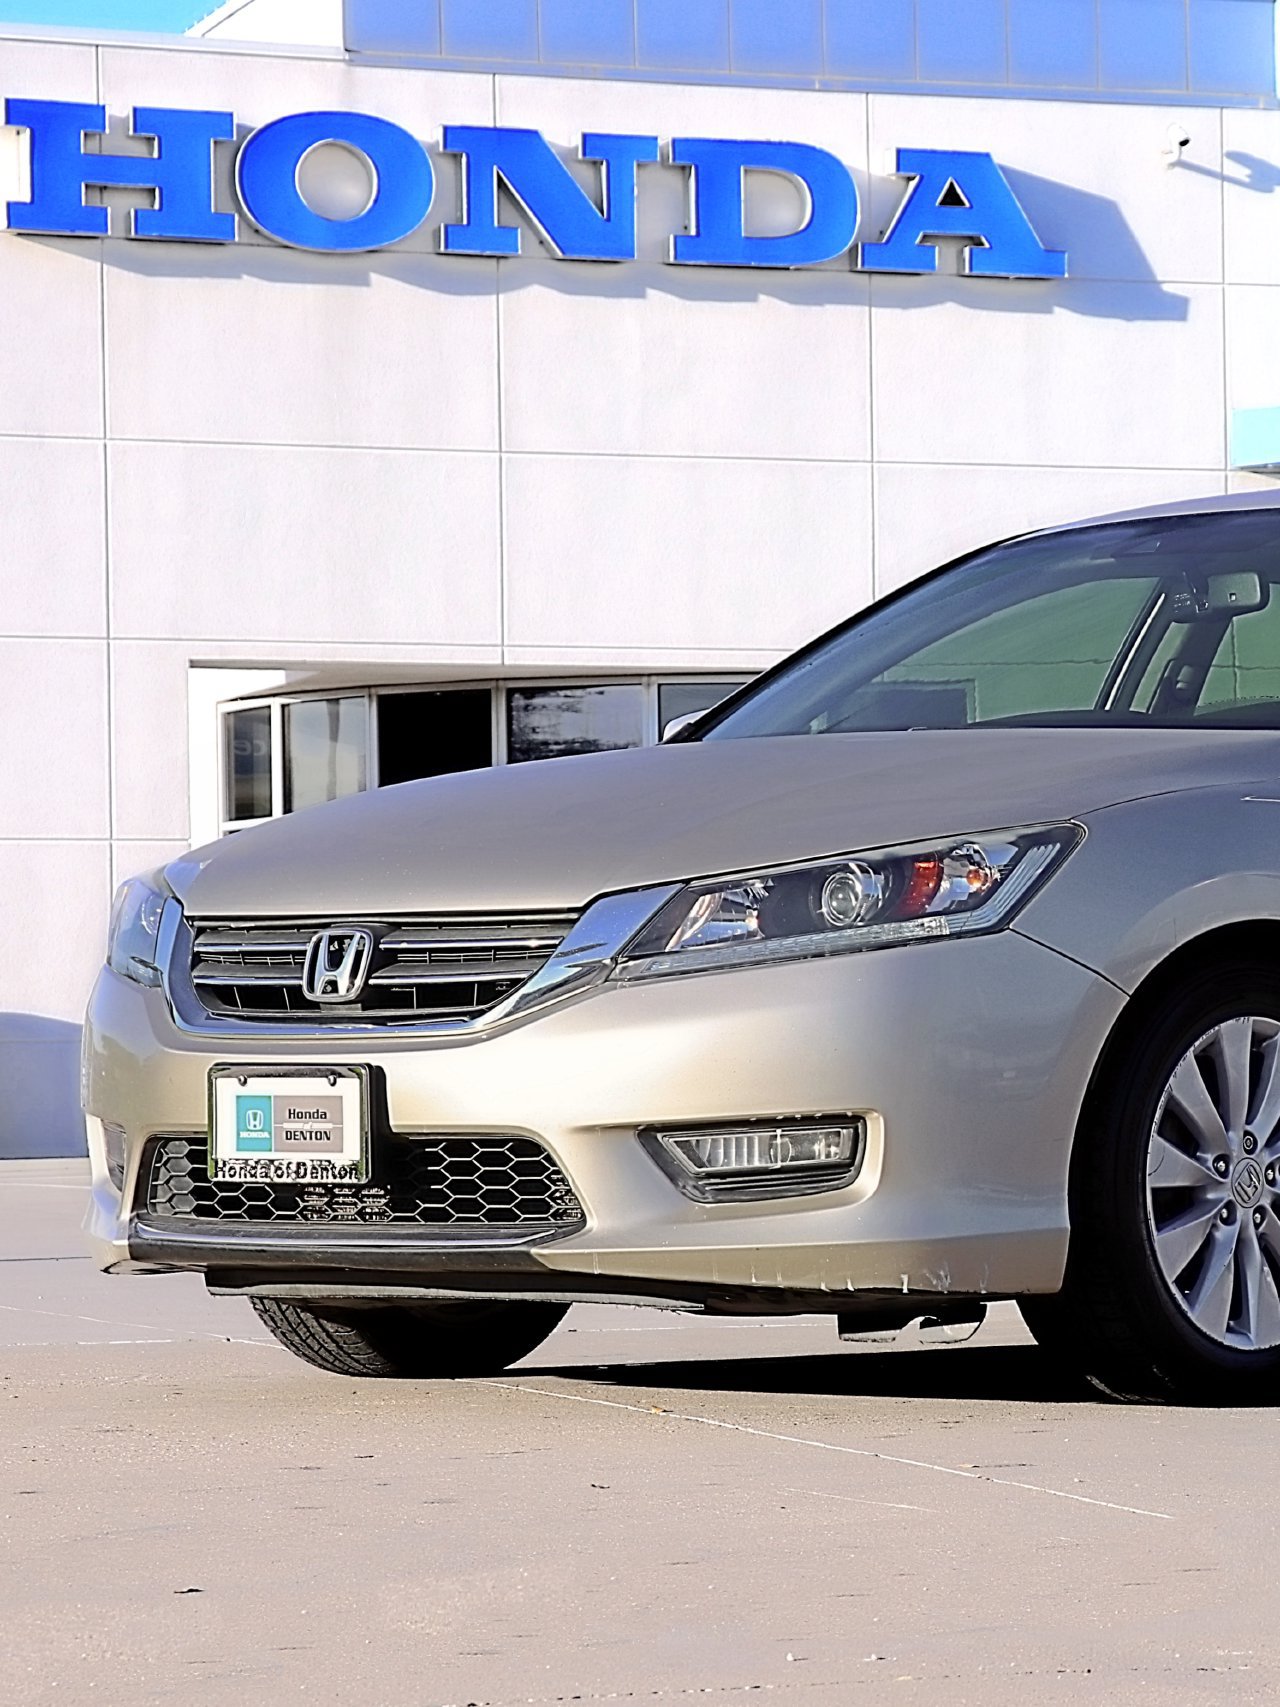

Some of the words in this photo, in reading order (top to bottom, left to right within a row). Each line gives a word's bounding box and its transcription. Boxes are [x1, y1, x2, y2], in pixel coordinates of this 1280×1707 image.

[5, 97, 1068, 279] HONDA
[287, 1108, 328, 1120] Honda
[285, 1130, 331, 1141] DENTON
[214, 1160, 269, 1179] Honda
[273, 1161, 294, 1179] of
[296, 1161, 359, 1180] Denton
